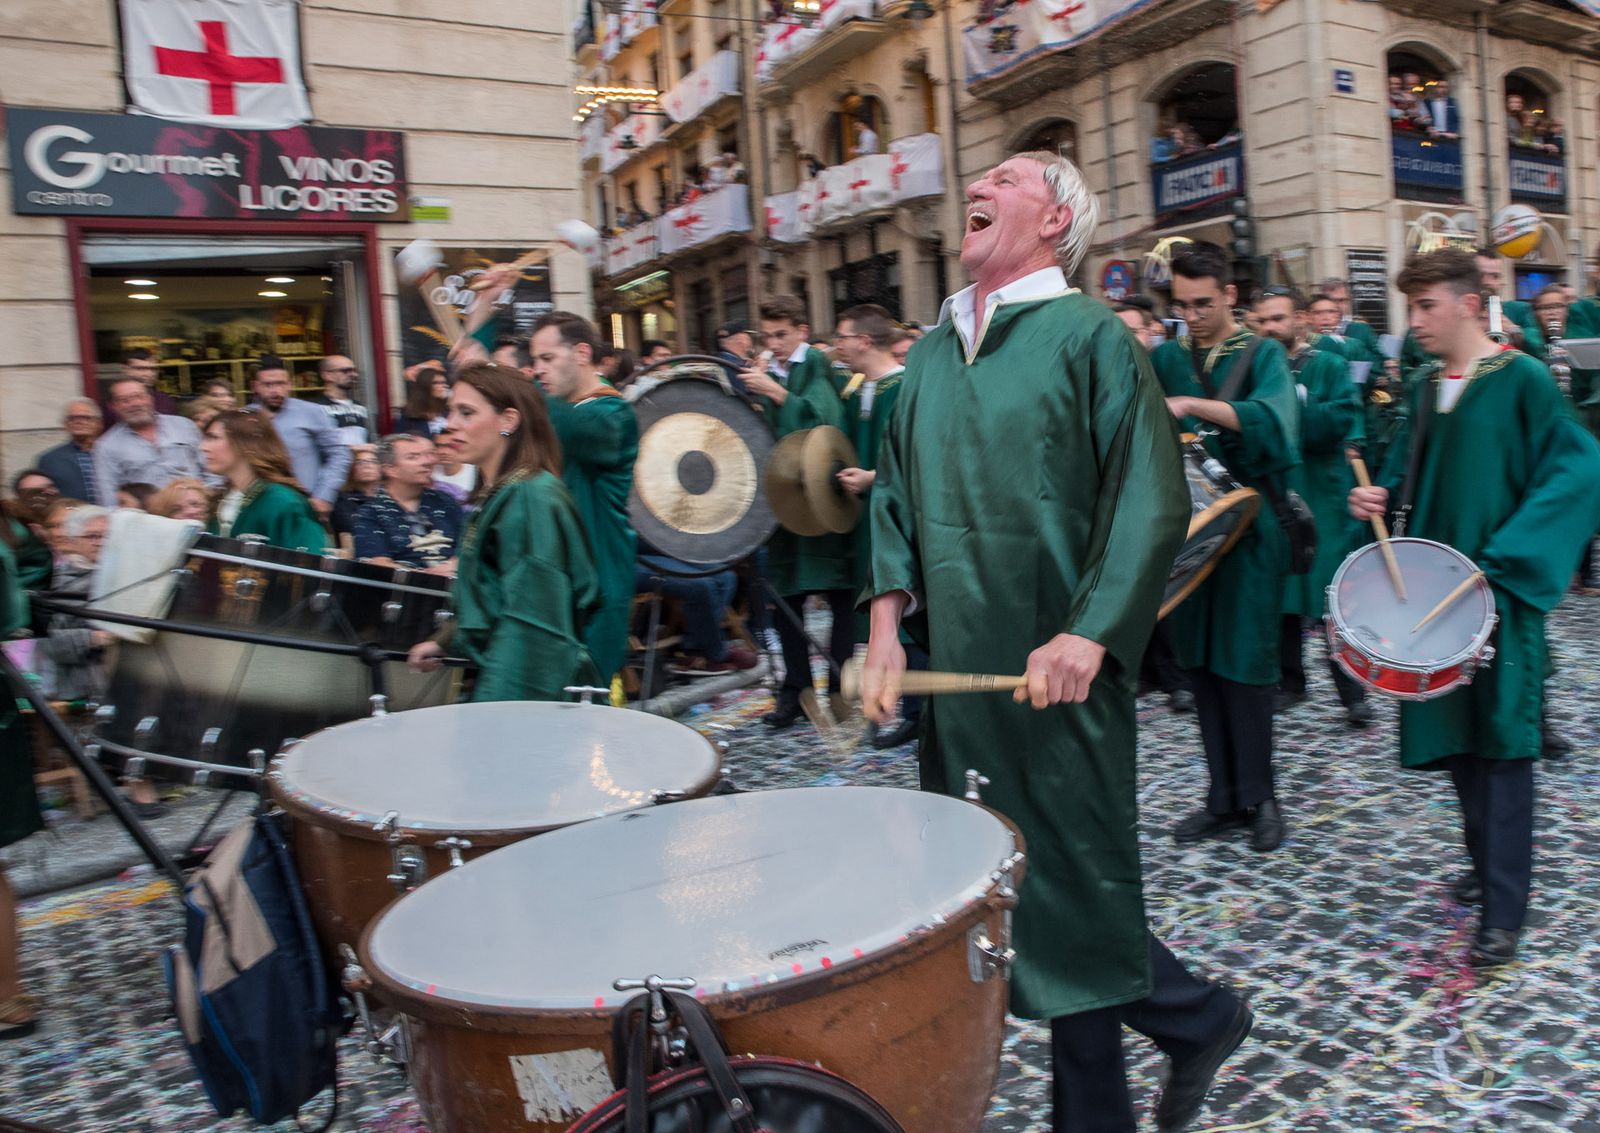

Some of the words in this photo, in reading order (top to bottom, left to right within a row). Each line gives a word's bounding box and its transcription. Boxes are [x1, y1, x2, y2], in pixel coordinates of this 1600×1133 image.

[24, 125, 240, 189] Gourmet
[278, 155, 395, 184] VINOS
[238, 184, 399, 213] LICORES
